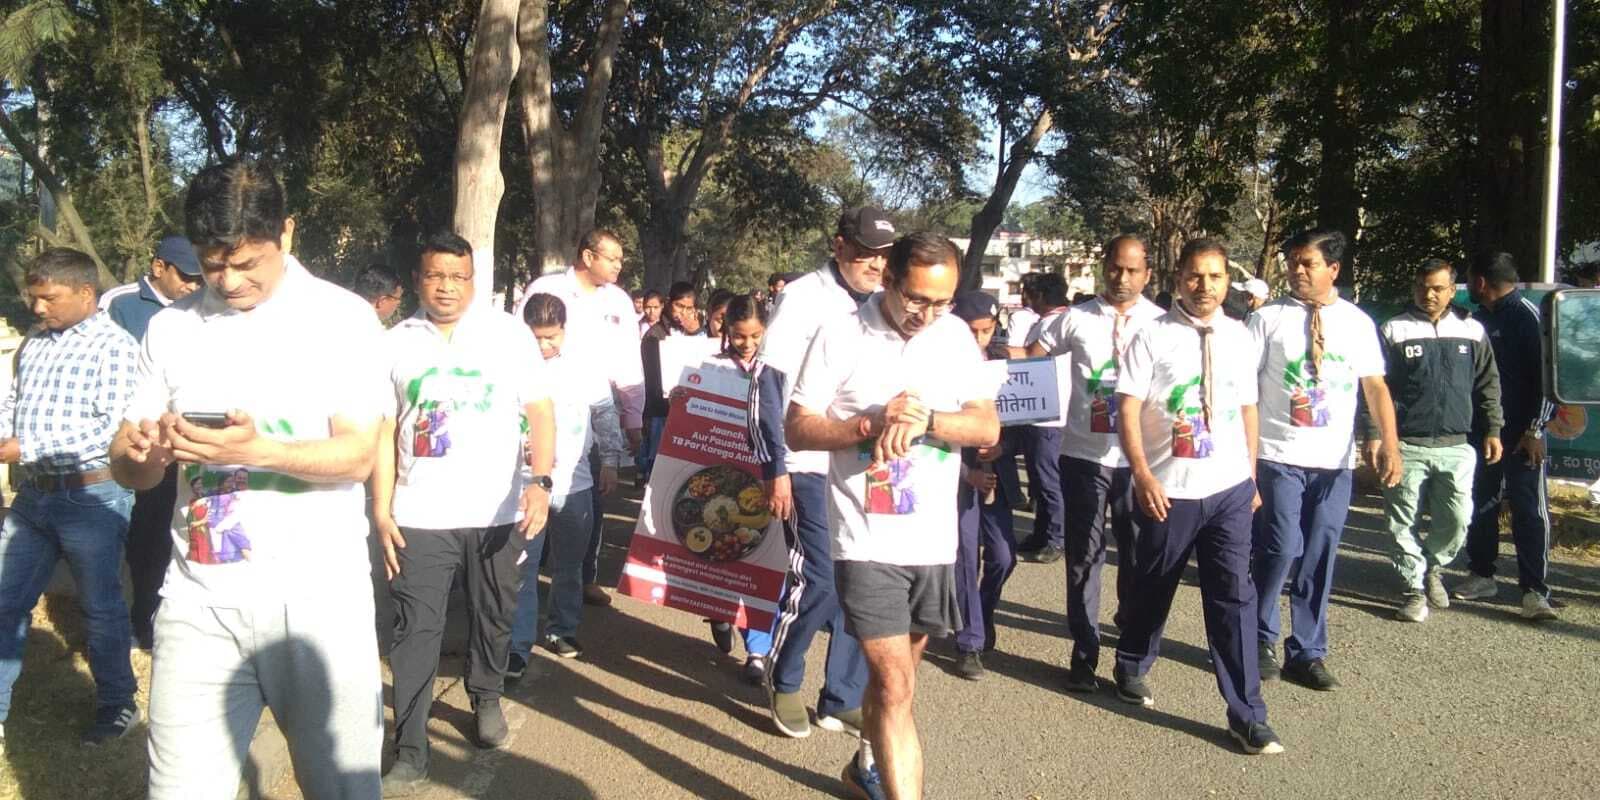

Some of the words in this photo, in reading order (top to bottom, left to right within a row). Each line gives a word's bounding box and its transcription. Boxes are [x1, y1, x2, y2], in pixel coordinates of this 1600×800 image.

[1405, 344, 1423, 358] 03
[710, 425, 746, 441] Jaanch,
[672, 436, 684, 446] TB
[684, 439, 700, 450] Par
[692, 431, 708, 441] Aur
[709, 435, 750, 453] Paushtik
